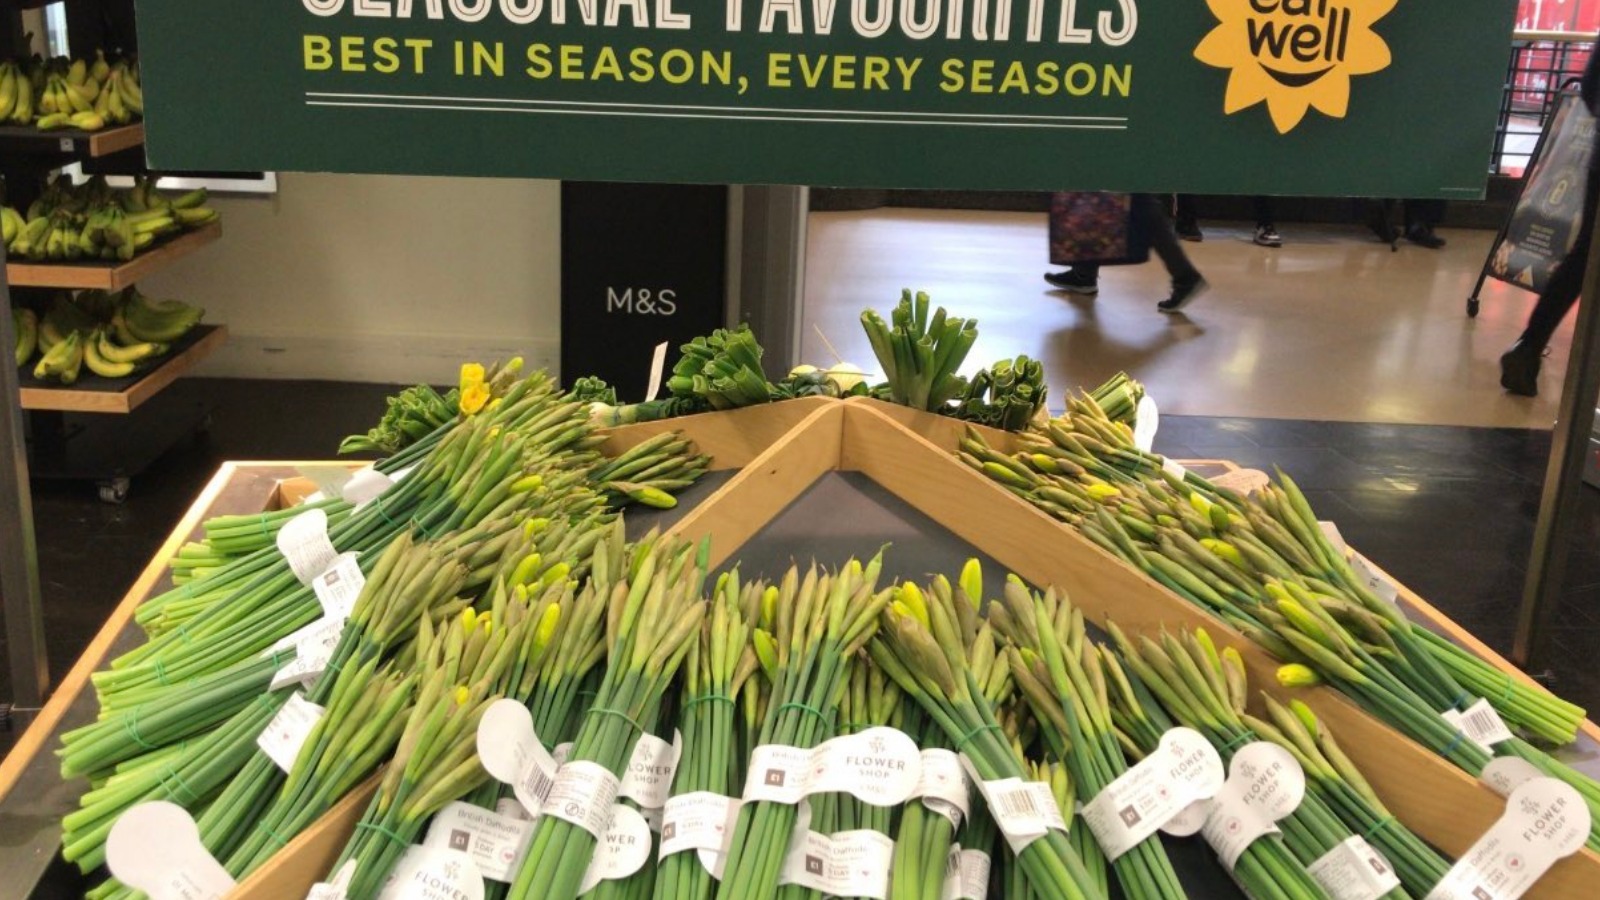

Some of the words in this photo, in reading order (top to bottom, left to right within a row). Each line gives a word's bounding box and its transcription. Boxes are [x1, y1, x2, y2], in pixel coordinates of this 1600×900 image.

[1246, 7, 1350, 62] well
[303, 35, 433, 74] BEST
[455, 40, 504, 77] IN
[526, 43, 748, 95] SEASON,
[768, 52, 923, 92] EVERY
[939, 58, 1132, 97] SEASON
[607, 286, 677, 315] M&S
[628, 763, 672, 776] LOWER
[846, 756, 906, 771] FLOWER
[859, 769, 890, 779] SHOP
[1170, 748, 1206, 779] FLOWER
[635, 775, 660, 785] SHOP
[1243, 761, 1283, 806] FLOWER
[1258, 780, 1280, 803] SHOP
[1522, 797, 1568, 843] FLOWER
[1543, 815, 1567, 840] SHOP
